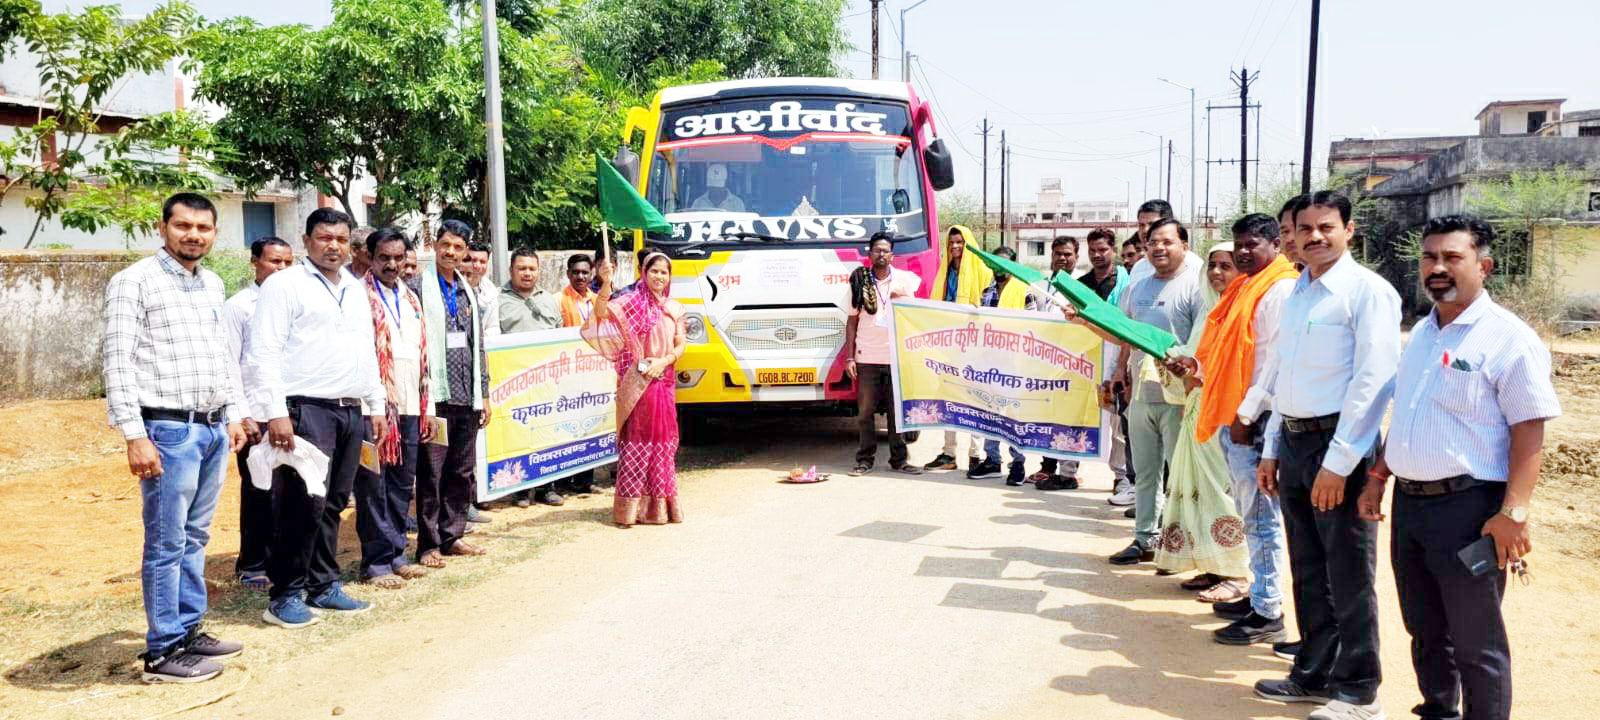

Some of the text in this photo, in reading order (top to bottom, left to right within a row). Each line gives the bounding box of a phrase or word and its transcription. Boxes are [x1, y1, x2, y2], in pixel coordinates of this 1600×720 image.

[674, 101, 887, 136] आशीर्वाद
[718, 274, 741, 291] शुभ
[823, 274, 849, 285] लाभ
[954, 321, 980, 353] कृषि
[983, 322, 1020, 353] विकास
[1022, 330, 1095, 380] योजनान्तर्गत
[491, 348, 607, 403] परम्परागत कृषि विकास
[924, 358, 1071, 392] कृषक शैक्षणिक भ्रमण
[511, 401, 554, 425] कृषक
[556, 391, 612, 413] शैक्षणिक
